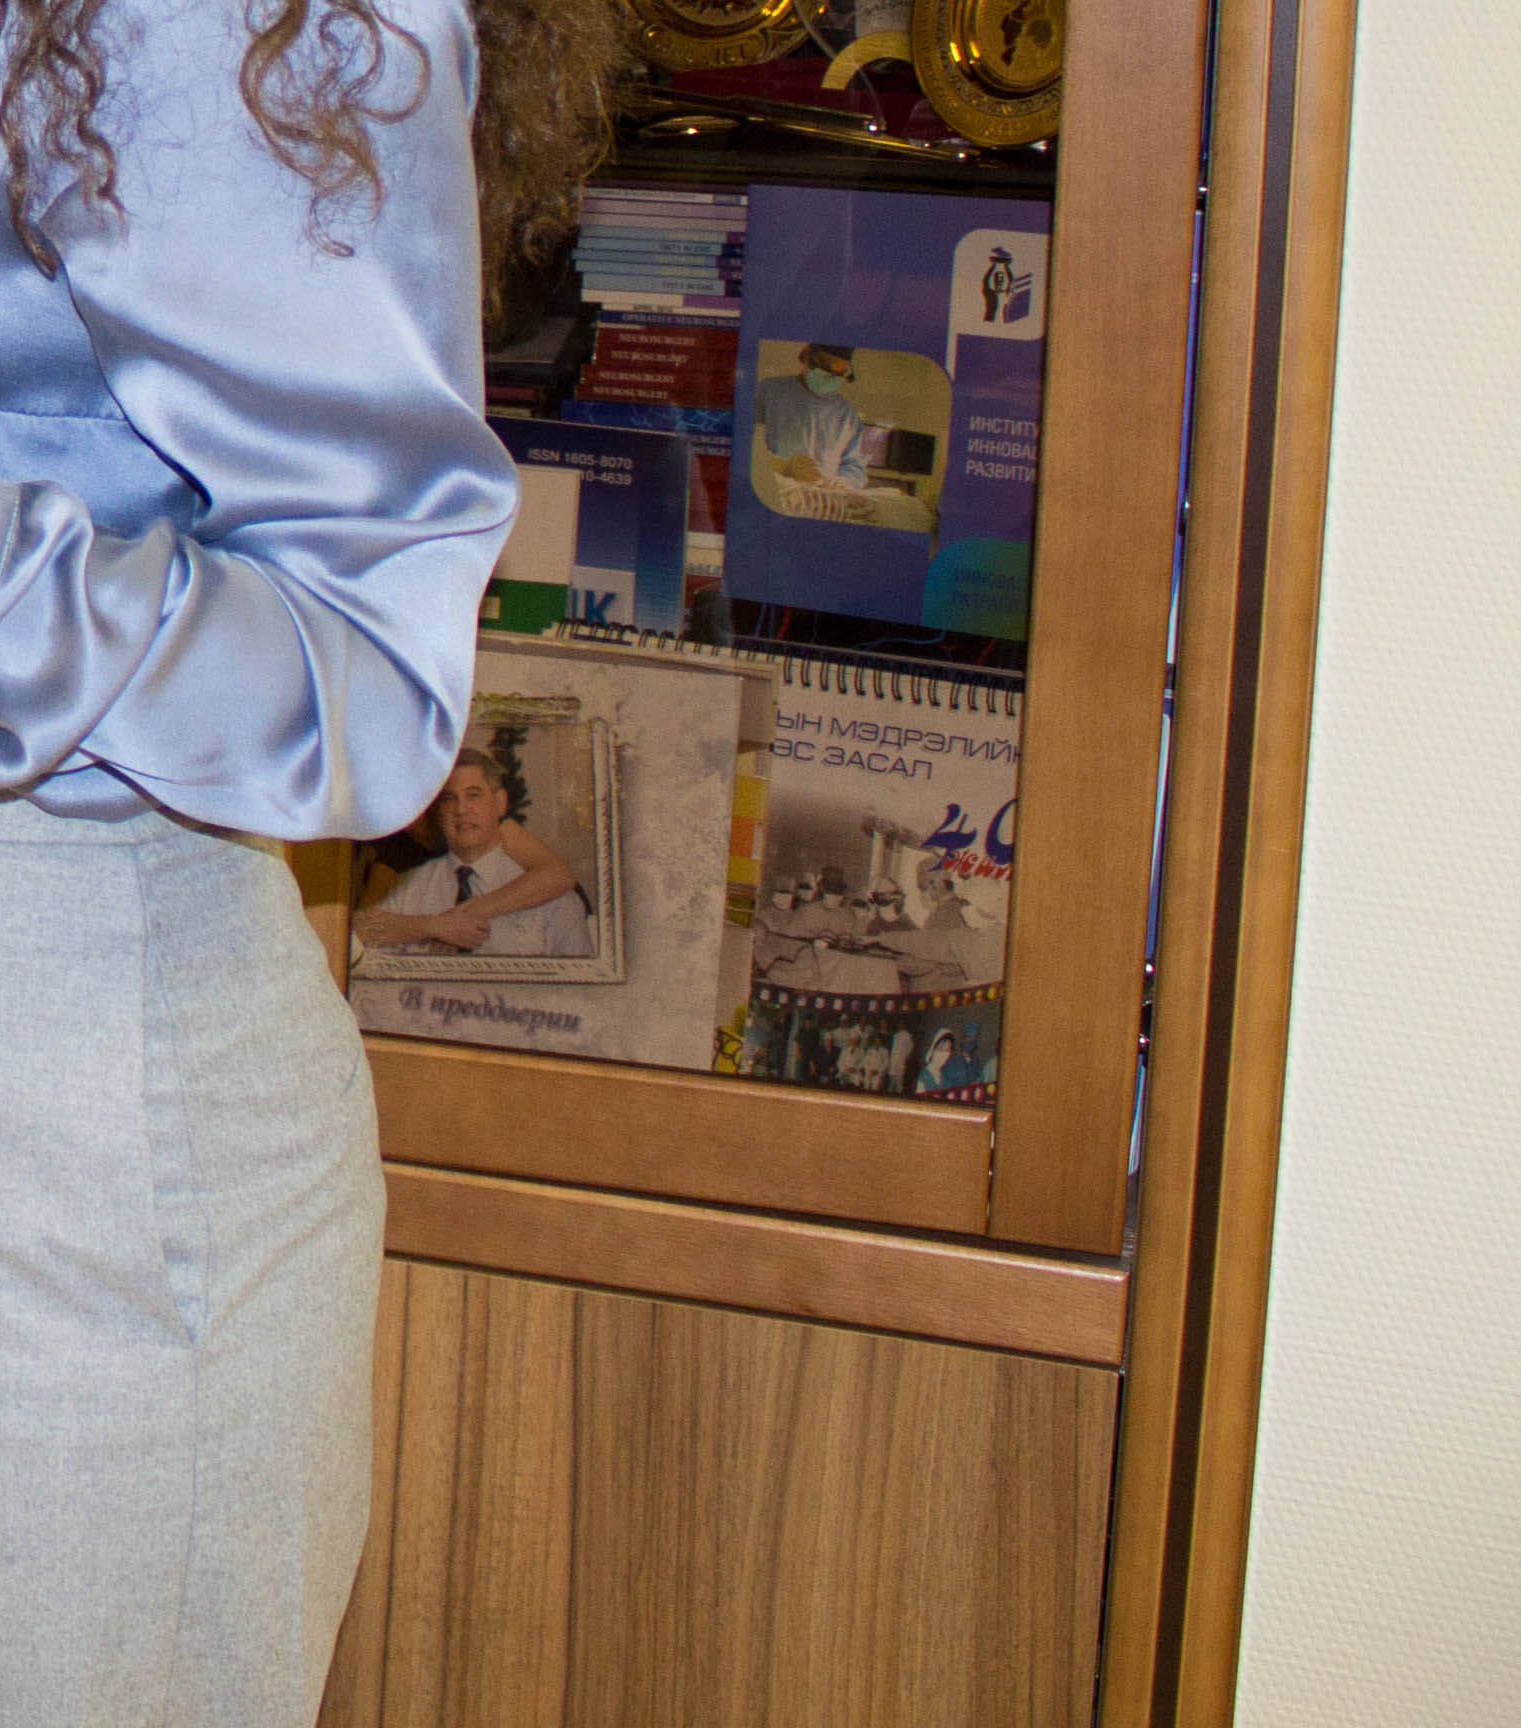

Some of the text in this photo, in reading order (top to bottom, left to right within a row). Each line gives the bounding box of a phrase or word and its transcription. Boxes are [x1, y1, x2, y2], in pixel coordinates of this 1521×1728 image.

[618, 332, 696, 346] NEUROSURGERY
[611, 350, 688, 364] NEUROSURGERY
[598, 370, 676, 384] NEUROSURGERY
[592, 386, 669, 400] NEUROSURGERY
[528, 448, 633, 470] ISSN 1605-8070
[823, 745, 933, 780] ЗАСАЛ
[428, 991, 583, 1034] преддверии
